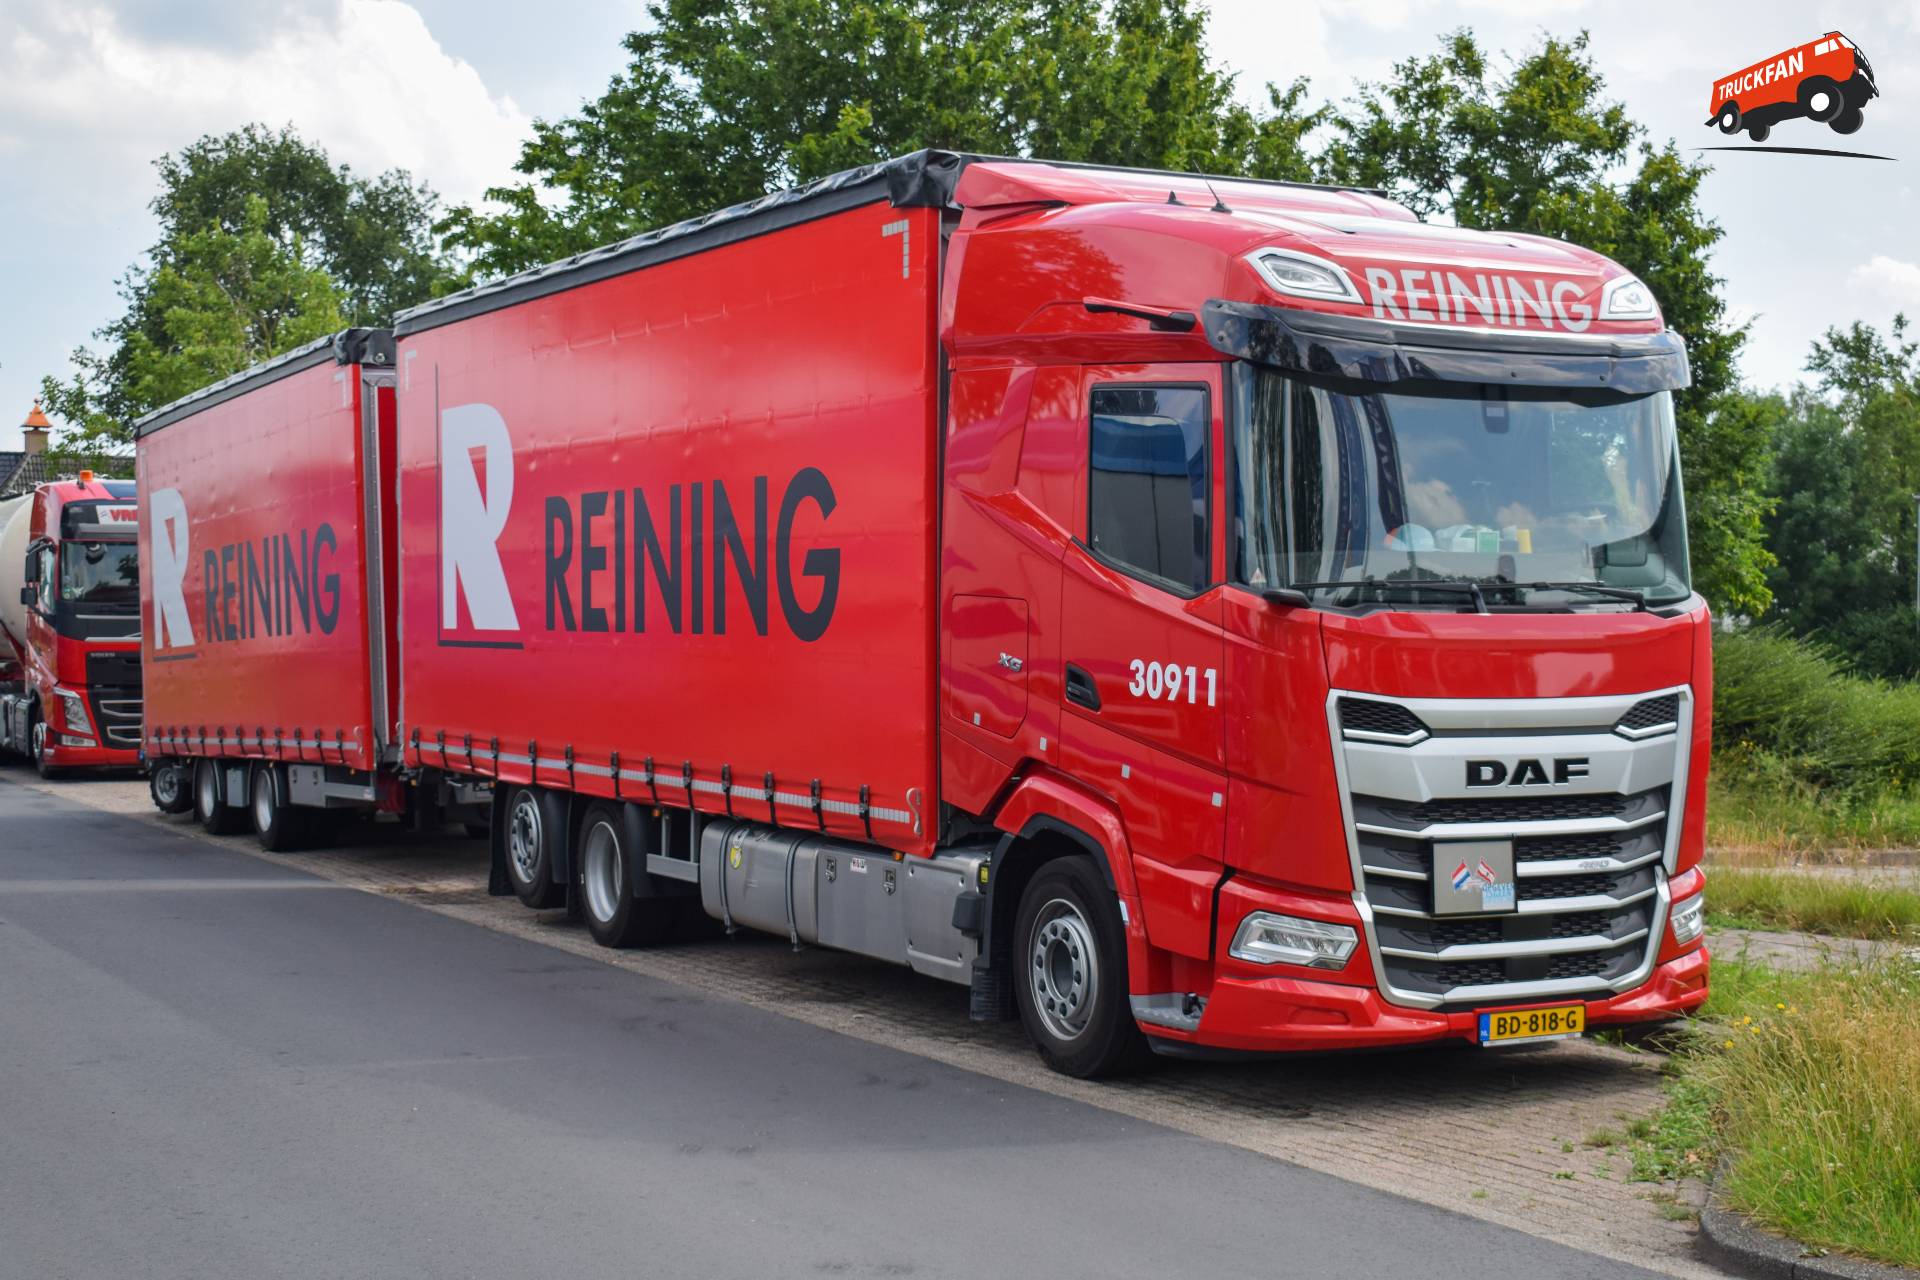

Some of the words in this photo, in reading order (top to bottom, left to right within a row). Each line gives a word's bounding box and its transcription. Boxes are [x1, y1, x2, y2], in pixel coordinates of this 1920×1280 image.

[1364, 267, 1592, 333] REINING
[442, 403, 520, 631] R
[204, 522, 340, 643] REINING
[545, 466, 841, 642] REINING
[998, 652, 1023, 672] XG
[1129, 659, 1217, 707] 30911
[1465, 757, 1589, 788] DAF
[1497, 1010, 1577, 1036] BD-818-G
